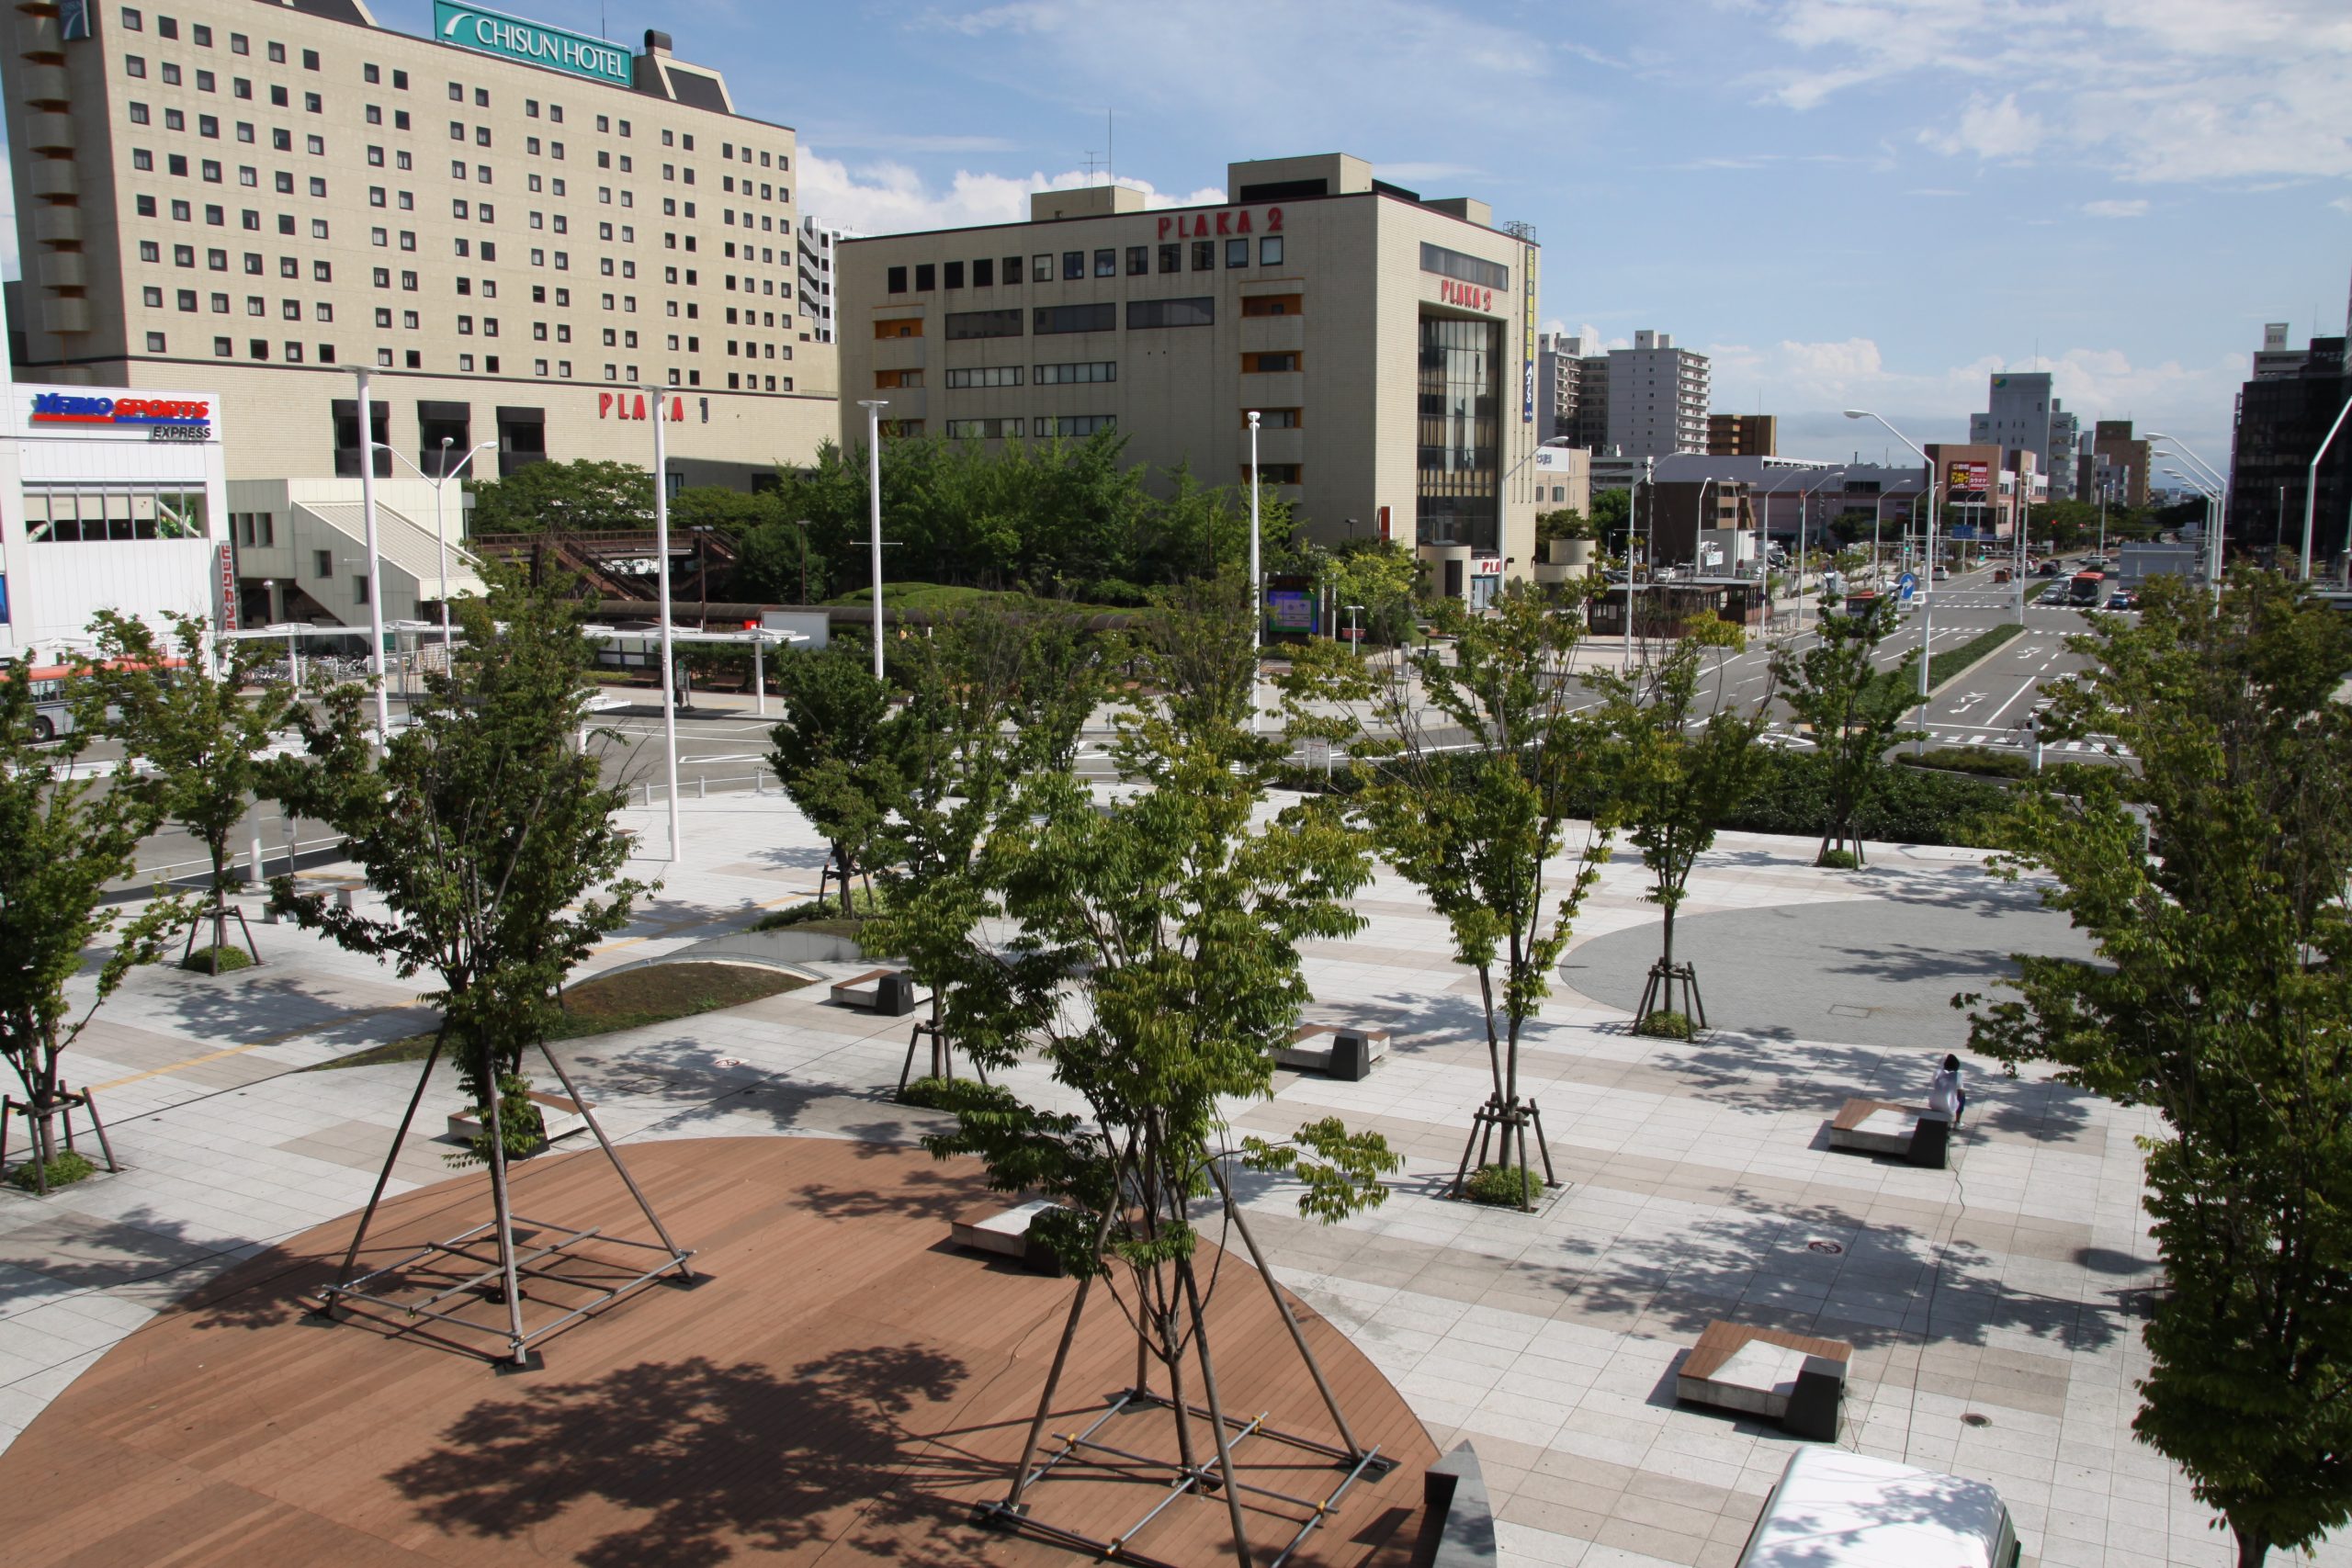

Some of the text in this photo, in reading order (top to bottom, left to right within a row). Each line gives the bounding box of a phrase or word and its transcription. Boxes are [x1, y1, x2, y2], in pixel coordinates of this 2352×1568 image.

[476, 18, 627, 78] CHISUN HOTEL
[1159, 207, 1283, 241] PLAKA 2
[1442, 279, 1491, 312] PLAKA 2
[34, 393, 209, 418] XEBIO SPORTS
[599, 392, 708, 423] PLAA 1
[153, 426, 211, 438] EXPRESS
